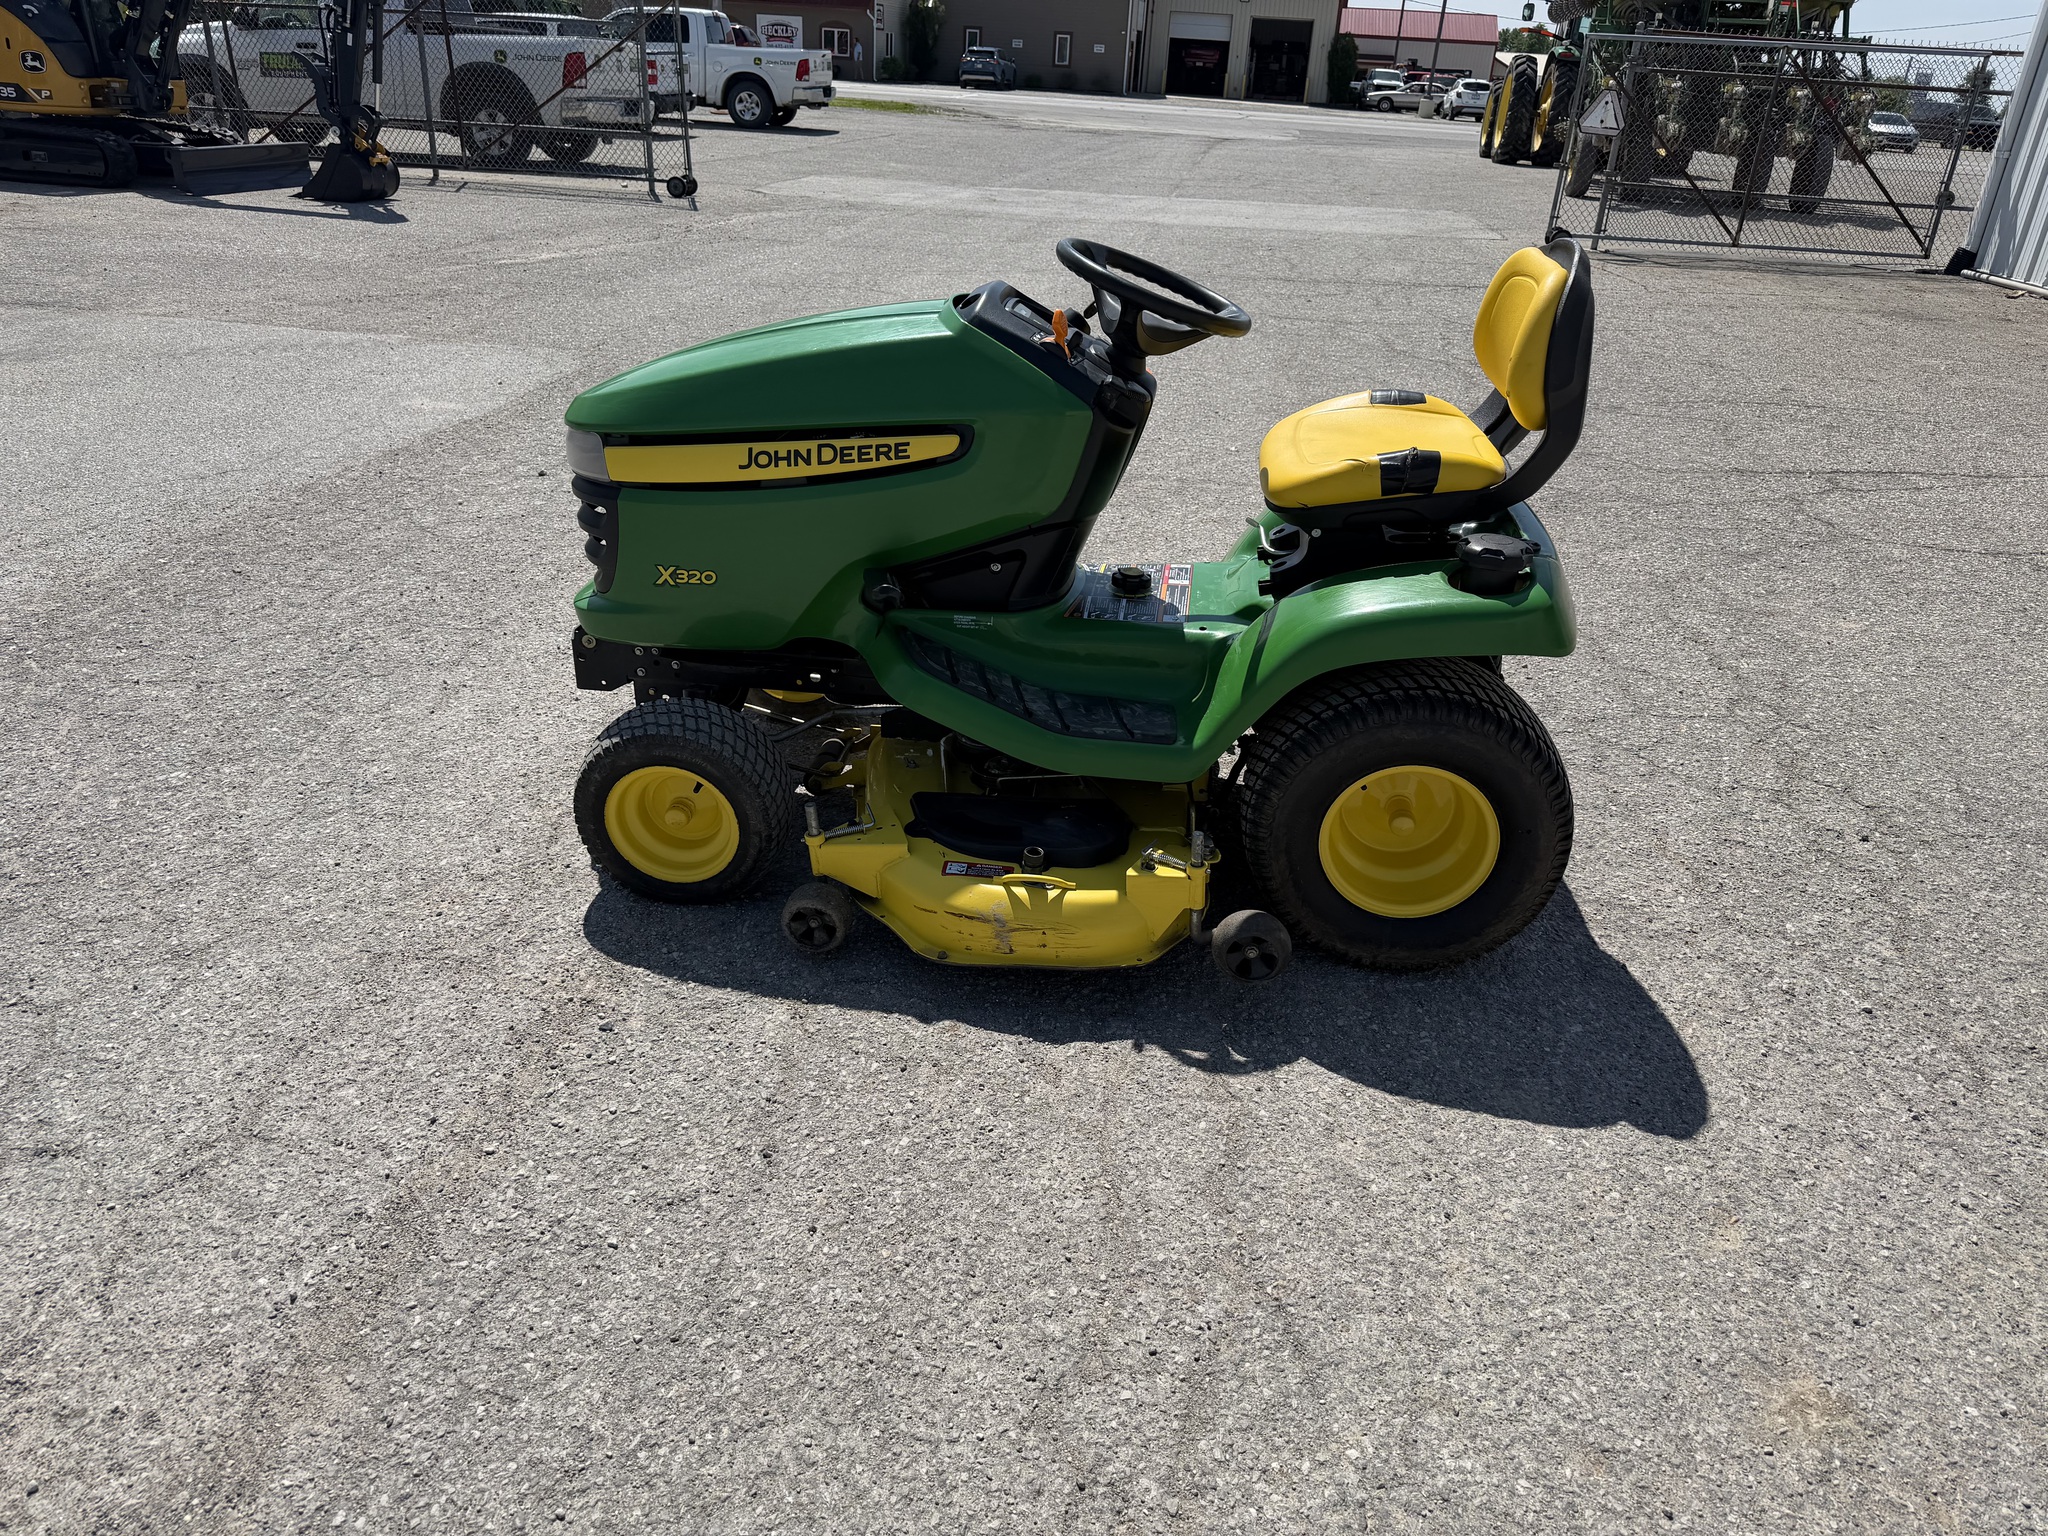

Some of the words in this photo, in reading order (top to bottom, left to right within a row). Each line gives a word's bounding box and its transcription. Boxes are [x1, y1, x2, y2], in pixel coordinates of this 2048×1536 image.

[762, 25, 798, 37] HECKLEY
[41, 90, 51, 99] P
[738, 447, 812, 470] JOHN
[817, 442, 911, 466] DEERE
[655, 565, 717, 586] X320
